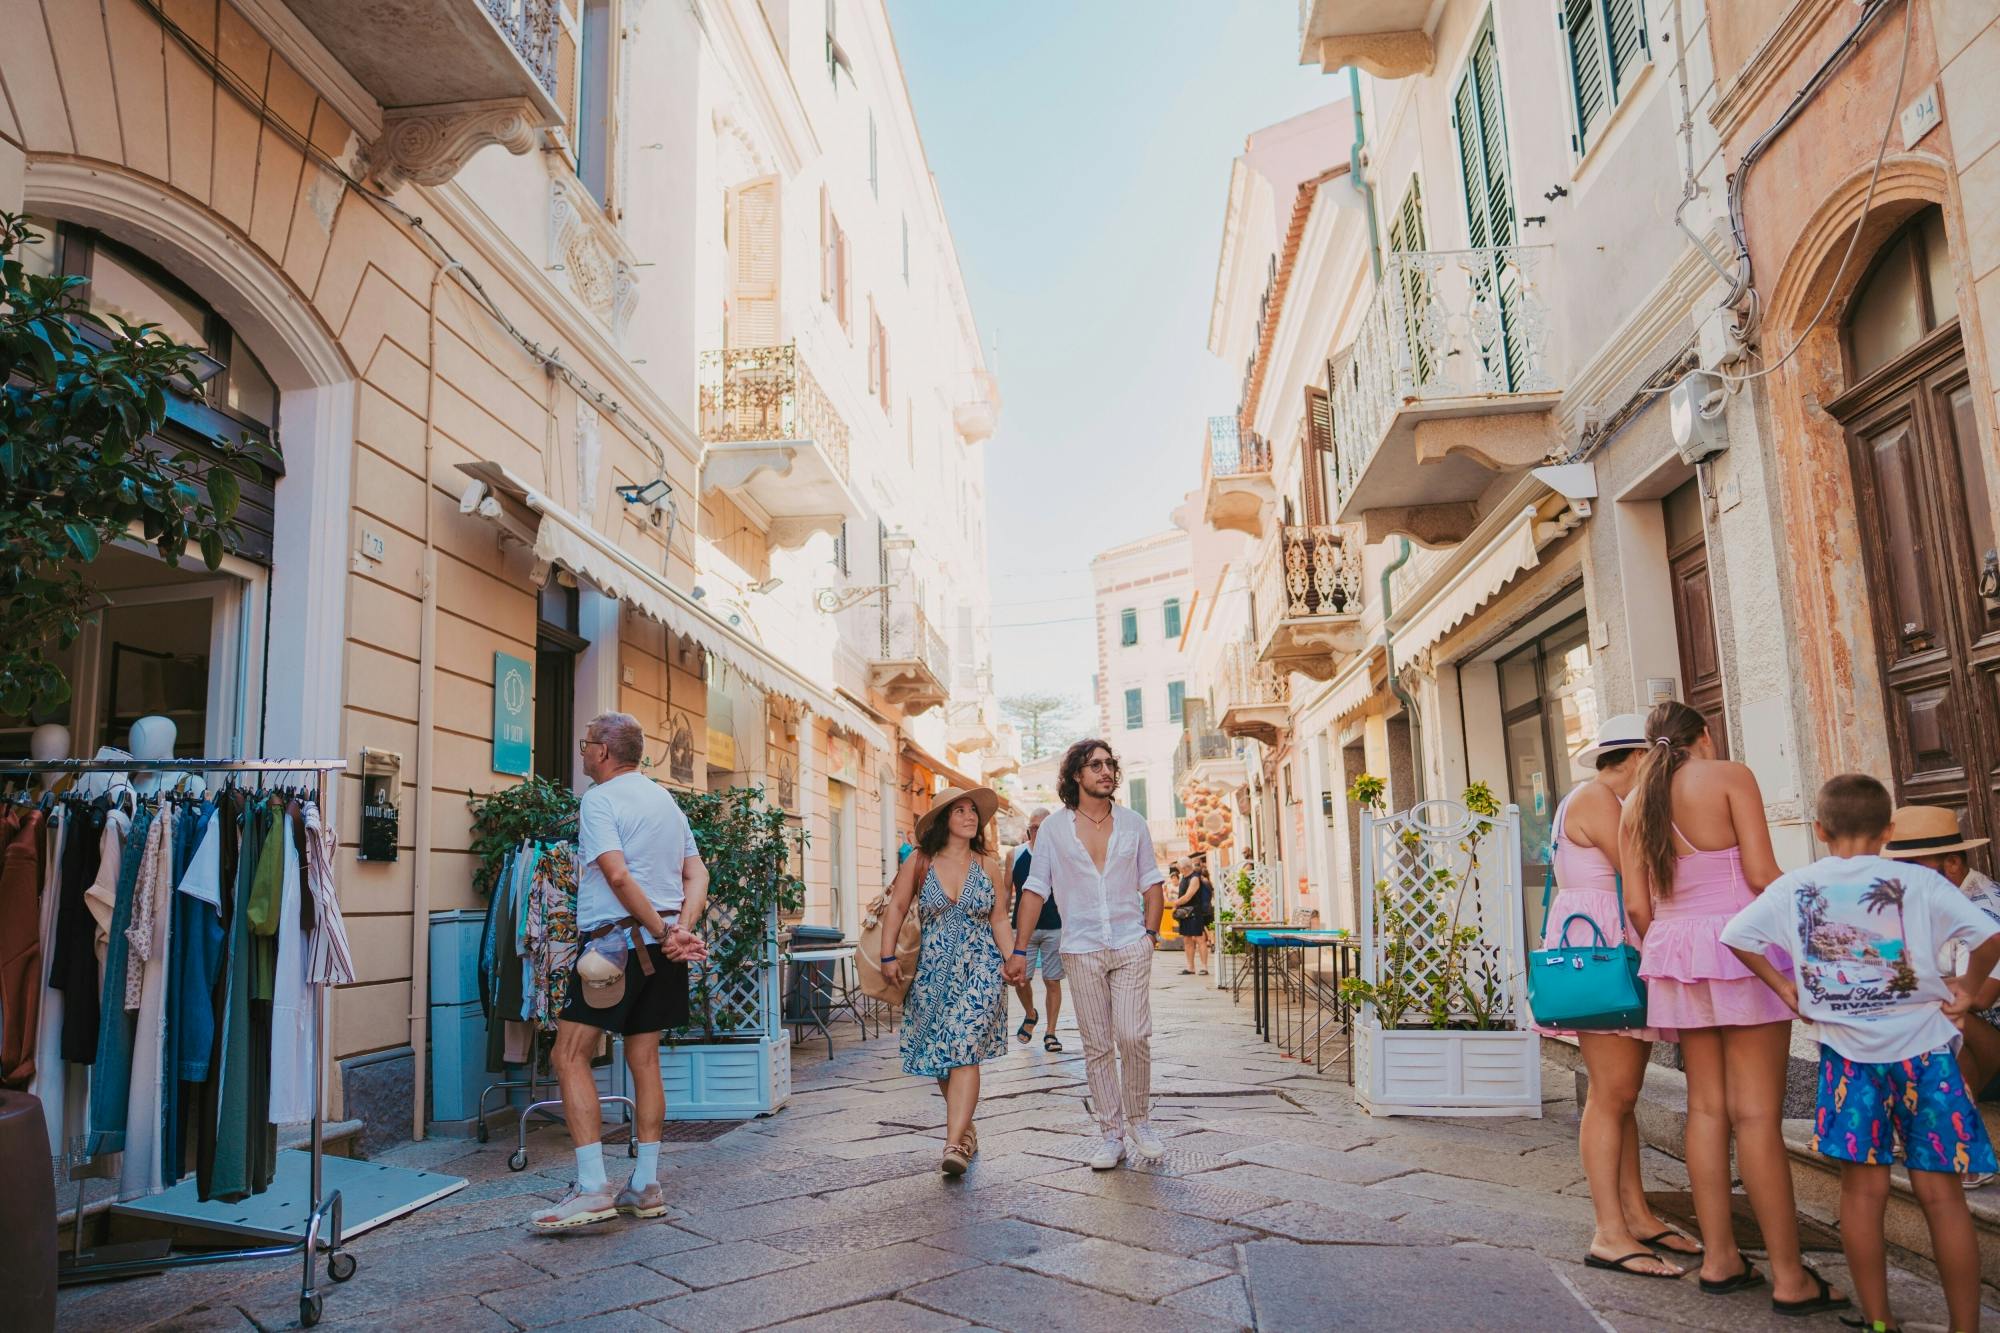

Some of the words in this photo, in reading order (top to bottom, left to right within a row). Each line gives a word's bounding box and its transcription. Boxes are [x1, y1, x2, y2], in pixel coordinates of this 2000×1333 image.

[1916, 95, 1934, 120] 94
[373, 538, 384, 554] 73
[365, 805, 382, 818] DAVID
[1830, 1001, 1897, 1011] RIVAG
